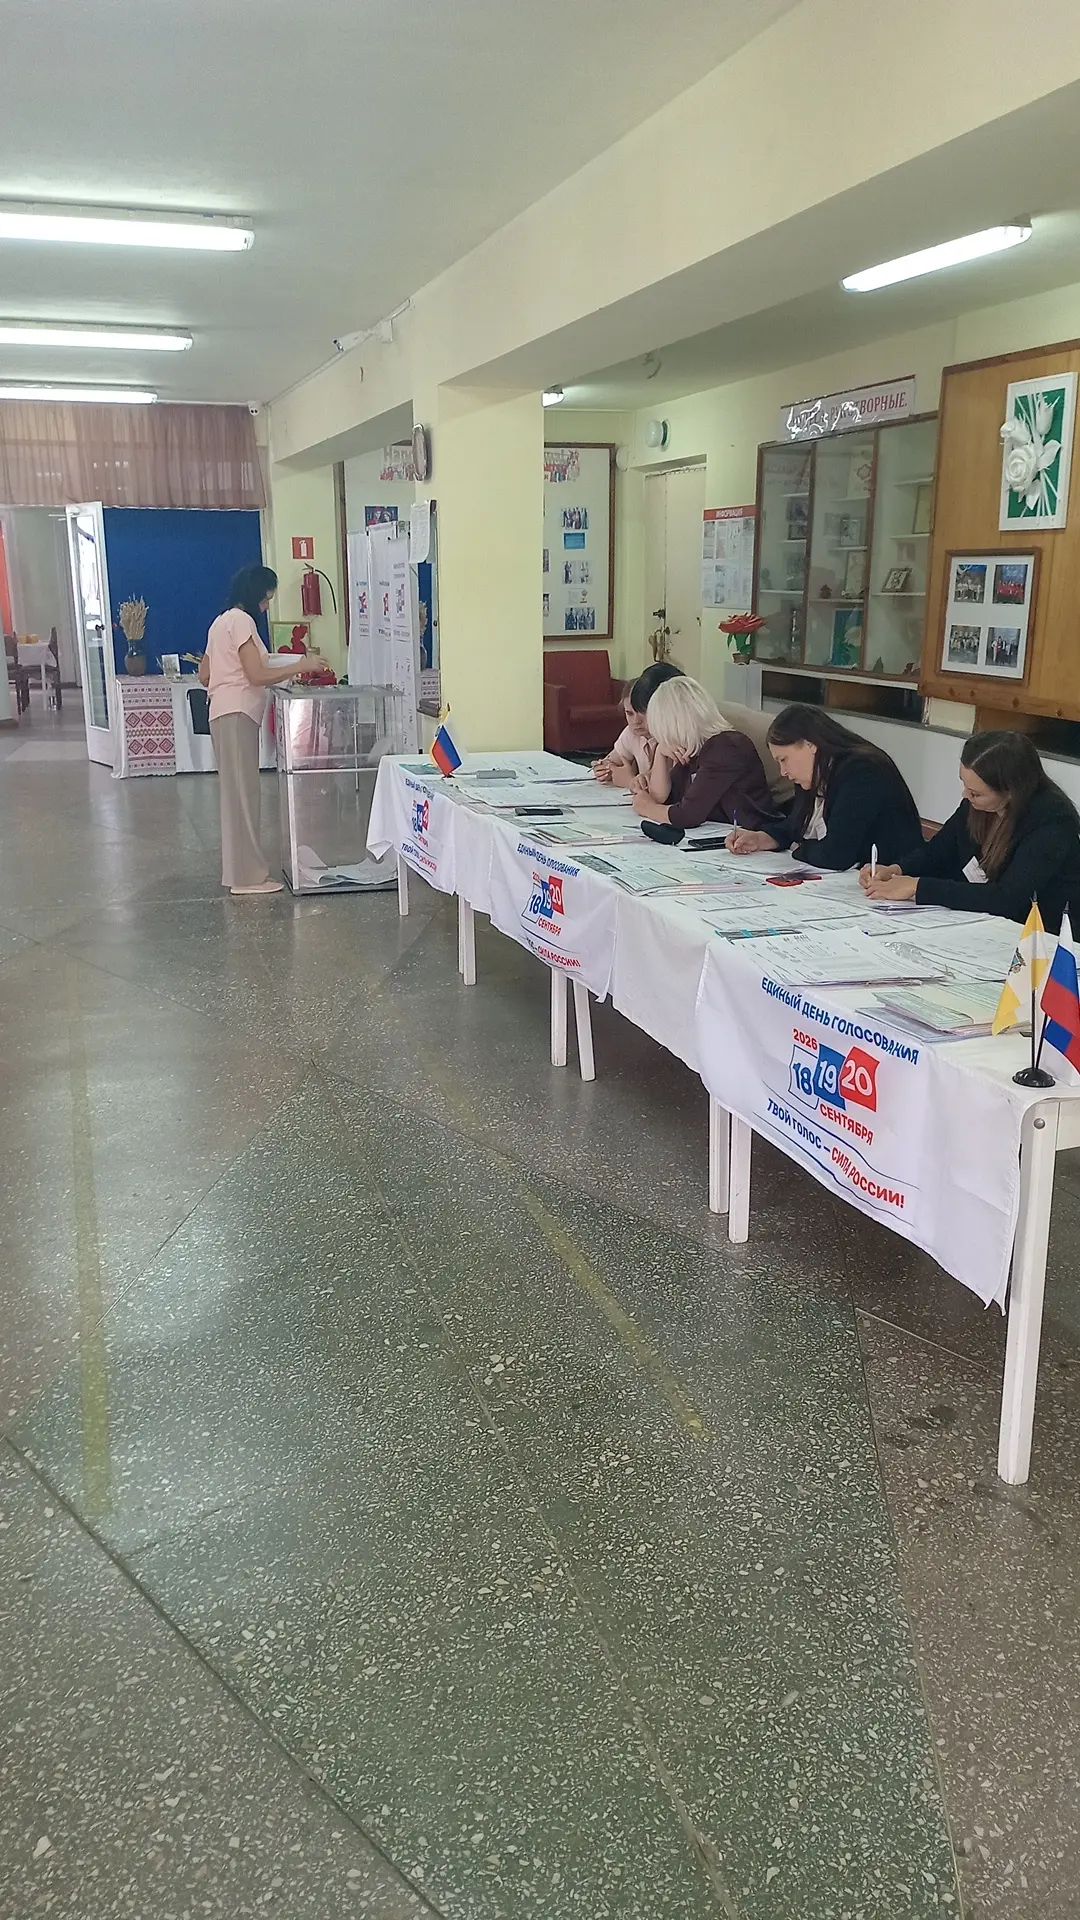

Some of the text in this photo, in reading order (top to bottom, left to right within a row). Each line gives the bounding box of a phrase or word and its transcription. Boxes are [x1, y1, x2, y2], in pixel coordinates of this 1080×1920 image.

[546, 858, 581, 877] ОЛОСОВАНИЯ
[529, 883, 562, 915] 18 19 20
[538, 917, 562, 937] СЕНТЯБРЯ
[549, 952, 581, 968] РОССИИ!
[761, 976, 920, 1066] ЕДИНЫЙ ДЕНЬ ГОЛОСОВАНИЯ
[793, 1028, 818, 1051] 2026
[792, 1058, 873, 1097] 18 19 20
[819, 1103, 874, 1146] СЕНТЯБРЯ
[766, 1098, 792, 1127] ТВОЙ
[792, 1118, 823, 1151] ГОЛОС
[831, 1147, 852, 1178] СИЛА
[851, 1167, 906, 1209] РОССИИ!
